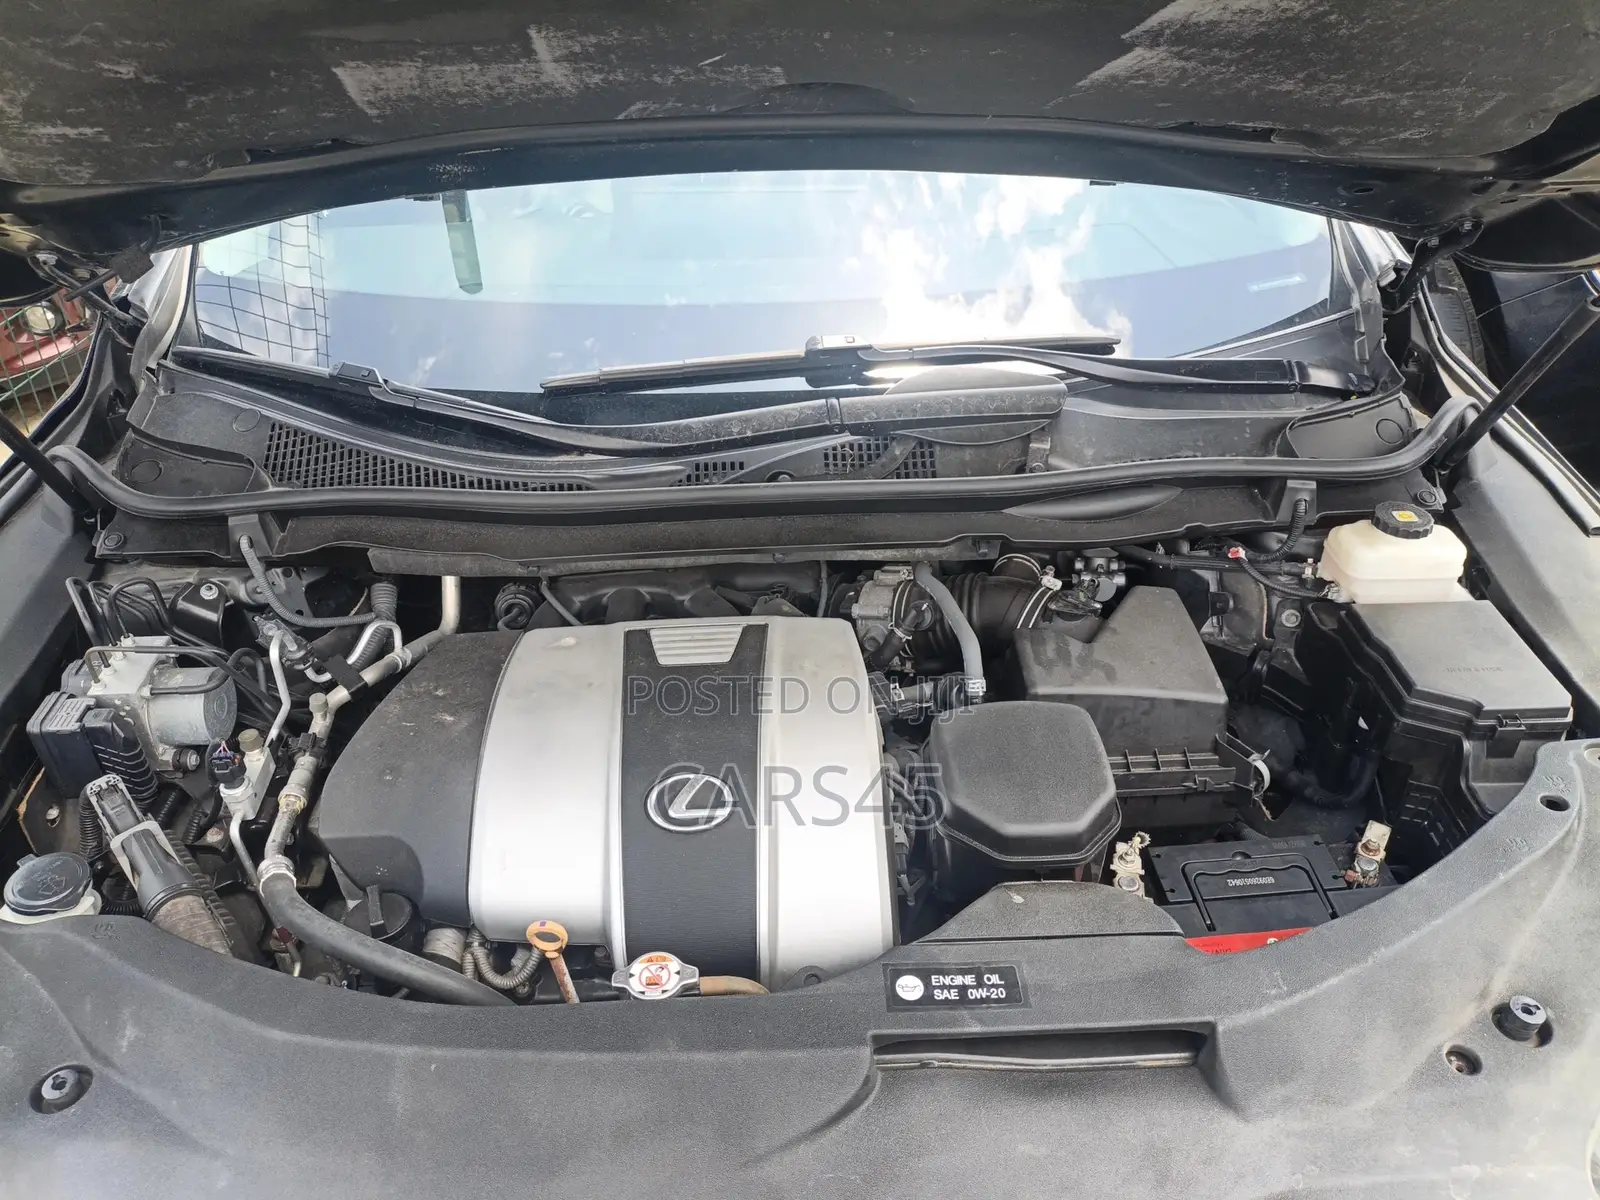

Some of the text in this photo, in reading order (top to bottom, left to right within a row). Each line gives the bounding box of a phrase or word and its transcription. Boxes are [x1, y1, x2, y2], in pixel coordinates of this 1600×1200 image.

[931, 974, 1005, 986] ENGINE OIL
[934, 988, 1006, 1000] SAE 0W-20
